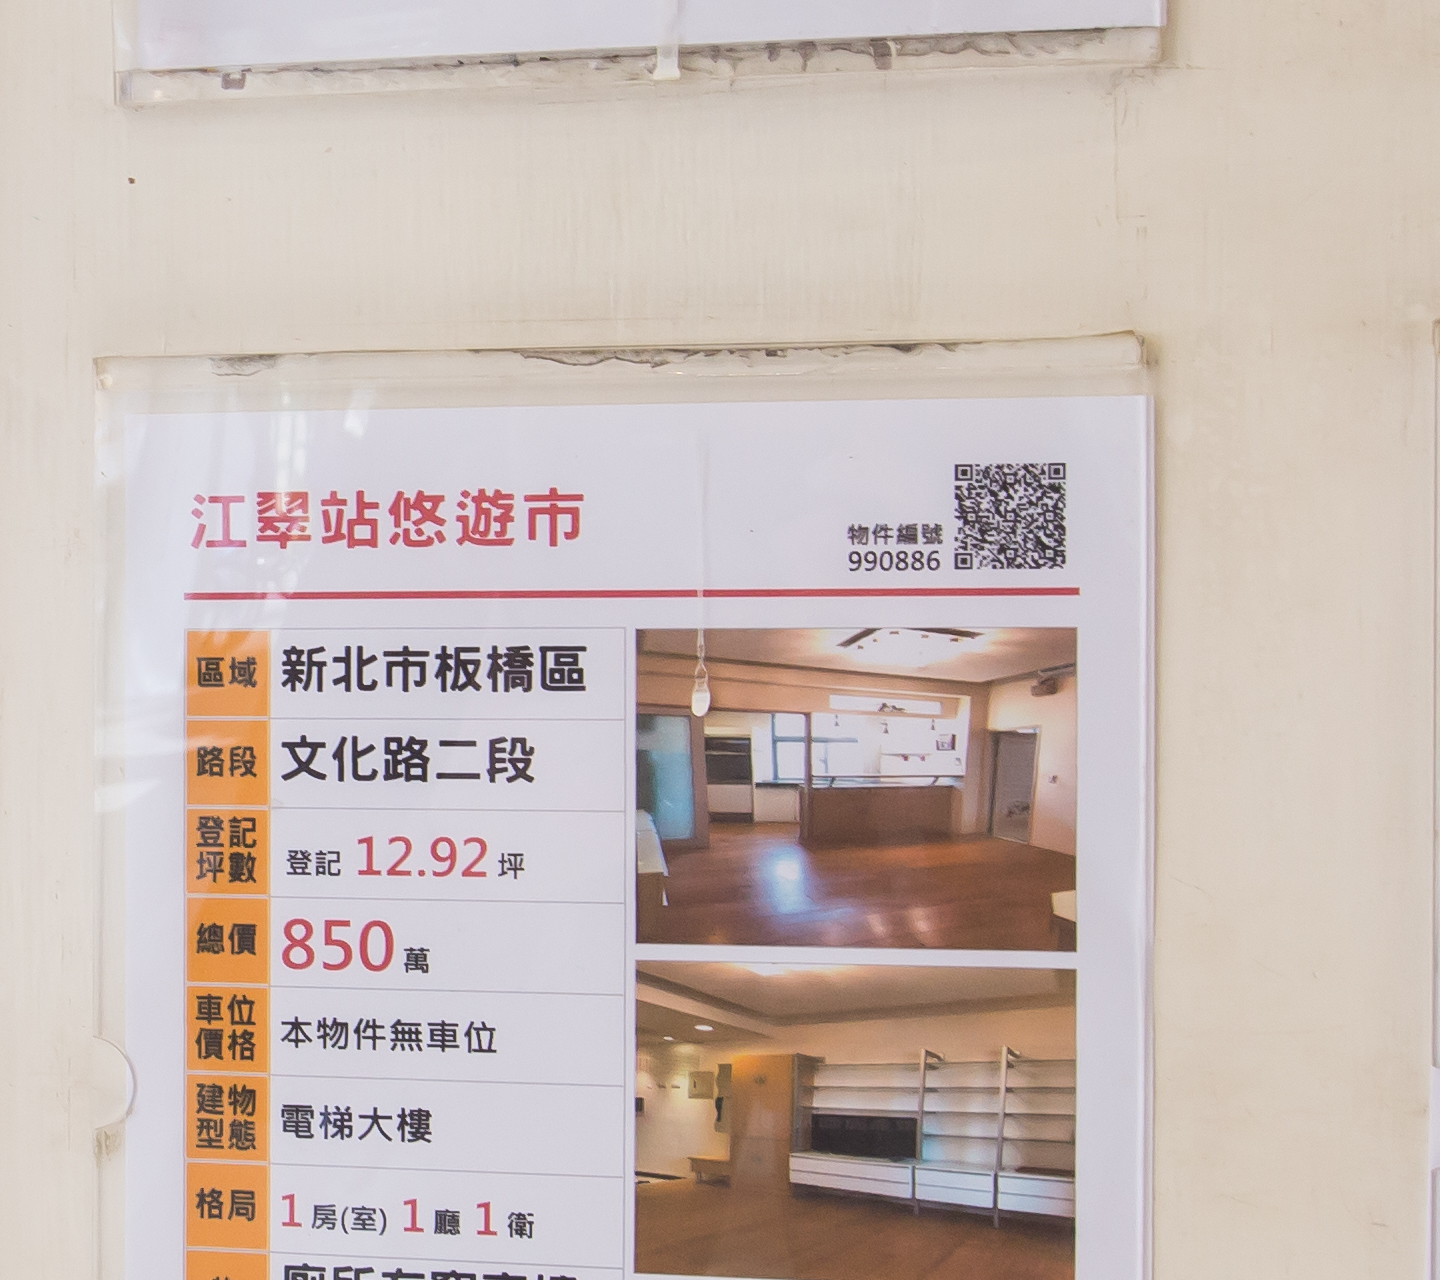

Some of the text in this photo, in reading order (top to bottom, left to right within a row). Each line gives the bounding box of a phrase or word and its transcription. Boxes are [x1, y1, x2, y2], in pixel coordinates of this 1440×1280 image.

[192, 486, 585, 550] 江翠站悠遊市
[847, 523, 944, 546] 物件編號
[847, 549, 941, 572] 990886
[196, 656, 258, 689] 區域
[281, 644, 588, 693] 新北市板橋區
[196, 745, 258, 778] 路段
[281, 734, 535, 784] 文化路二段
[195, 815, 258, 849] 登記
[196, 850, 257, 884] 坪數
[286, 835, 525, 880] 登記 12.92 坪
[196, 922, 257, 956] 總價
[281, 918, 430, 974] 850 萬
[195, 993, 257, 1027] 車位
[194, 1026, 256, 1062] 價格
[280, 1016, 497, 1054] 本物件無車位
[195, 1082, 257, 1118] 建物
[195, 1117, 257, 1152] 型態
[280, 1103, 433, 1144] 電梯大樓
[195, 1187, 256, 1223] 格局
[281, 1193, 535, 1239] 1 房(室) 1 廳 1 衛
